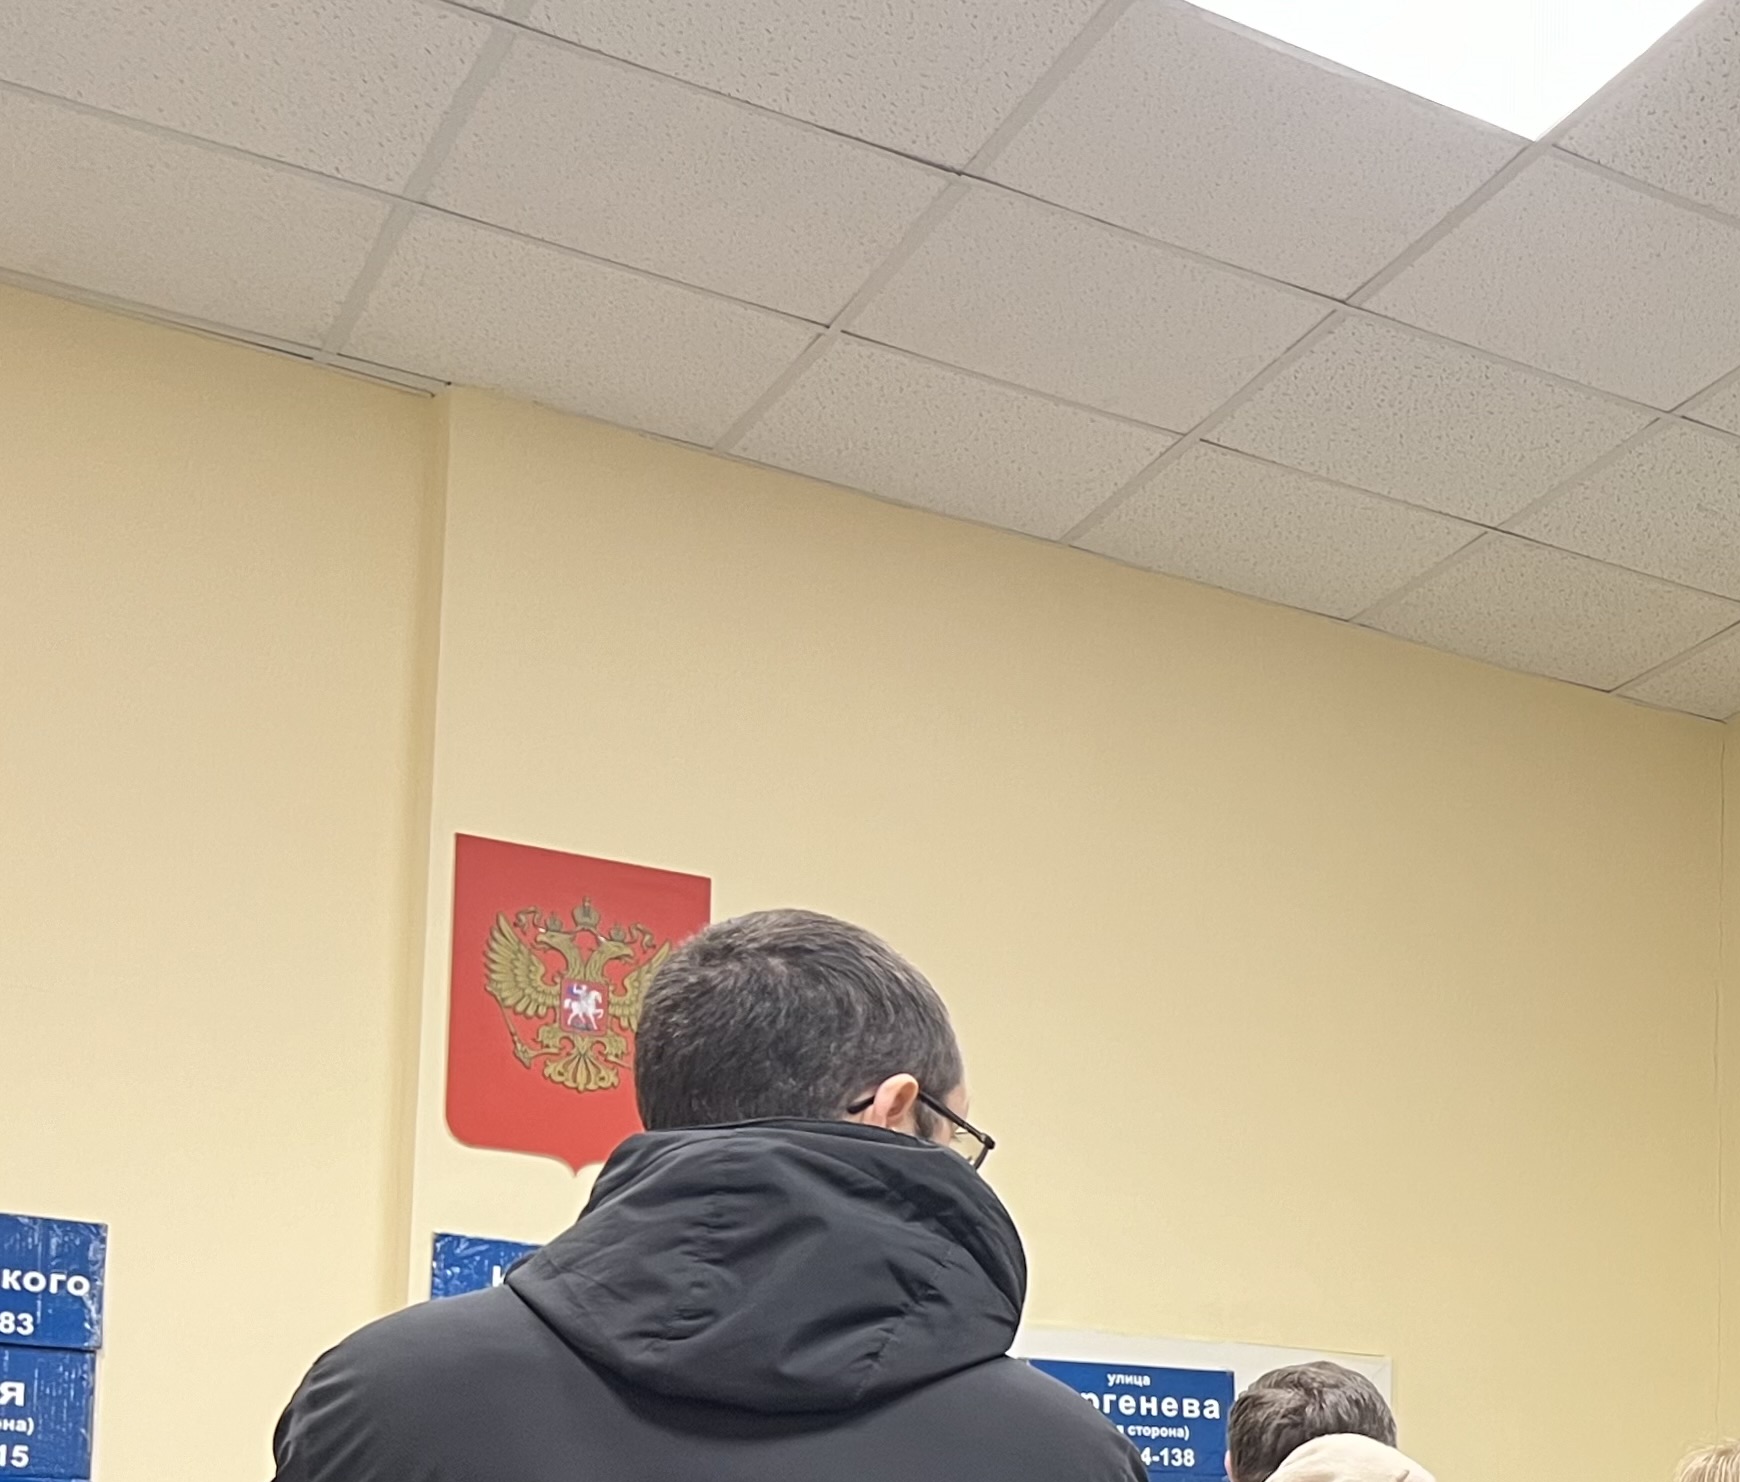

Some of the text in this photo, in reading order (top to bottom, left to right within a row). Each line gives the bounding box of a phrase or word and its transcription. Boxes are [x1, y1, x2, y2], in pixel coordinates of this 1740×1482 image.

[2, 1269, 90, 1296] кого
[0, 1311, 34, 1336] 83
[1107, 1373, 1150, 1387] улица
[0, 1417, 34, 1436] на)
[1128, 1424, 1190, 1441] сторона)
